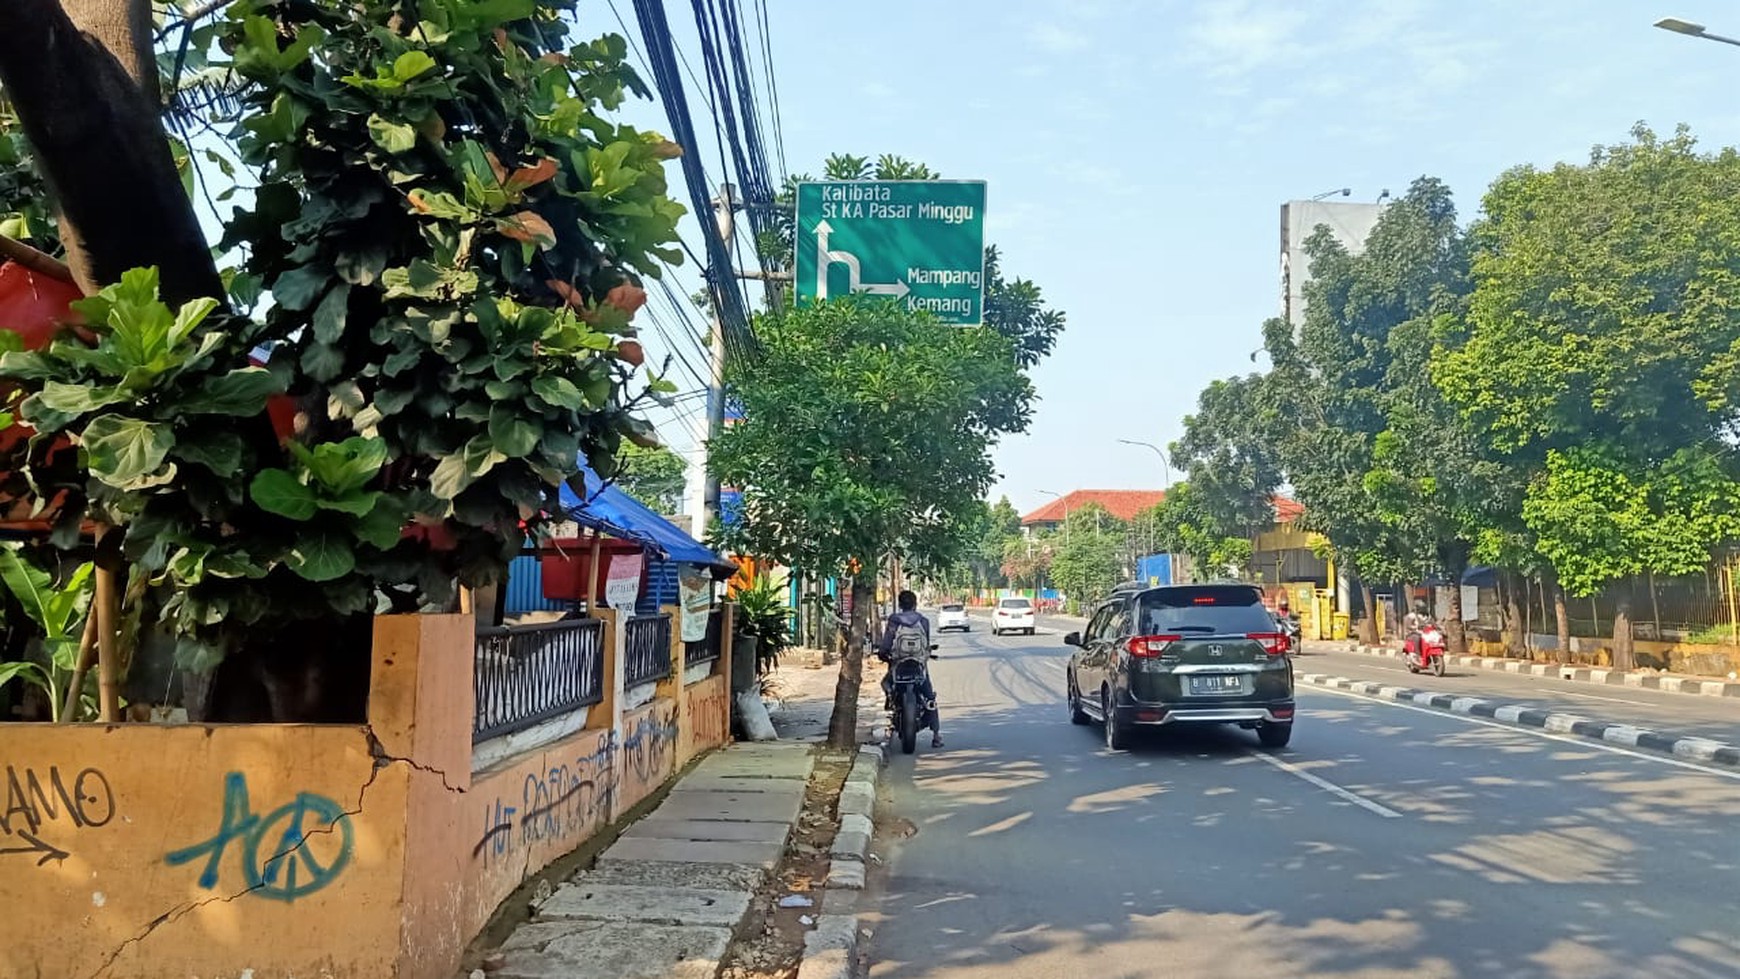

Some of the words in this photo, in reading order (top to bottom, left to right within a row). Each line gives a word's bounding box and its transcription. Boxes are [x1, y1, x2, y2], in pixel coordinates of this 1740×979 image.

[822, 185, 891, 201] Kalibata
[822, 202, 837, 218] St
[869, 203, 912, 219] Pasar
[918, 202, 974, 224] Minggu
[907, 268, 980, 288] Mampang
[907, 296, 971, 316] Kemang
